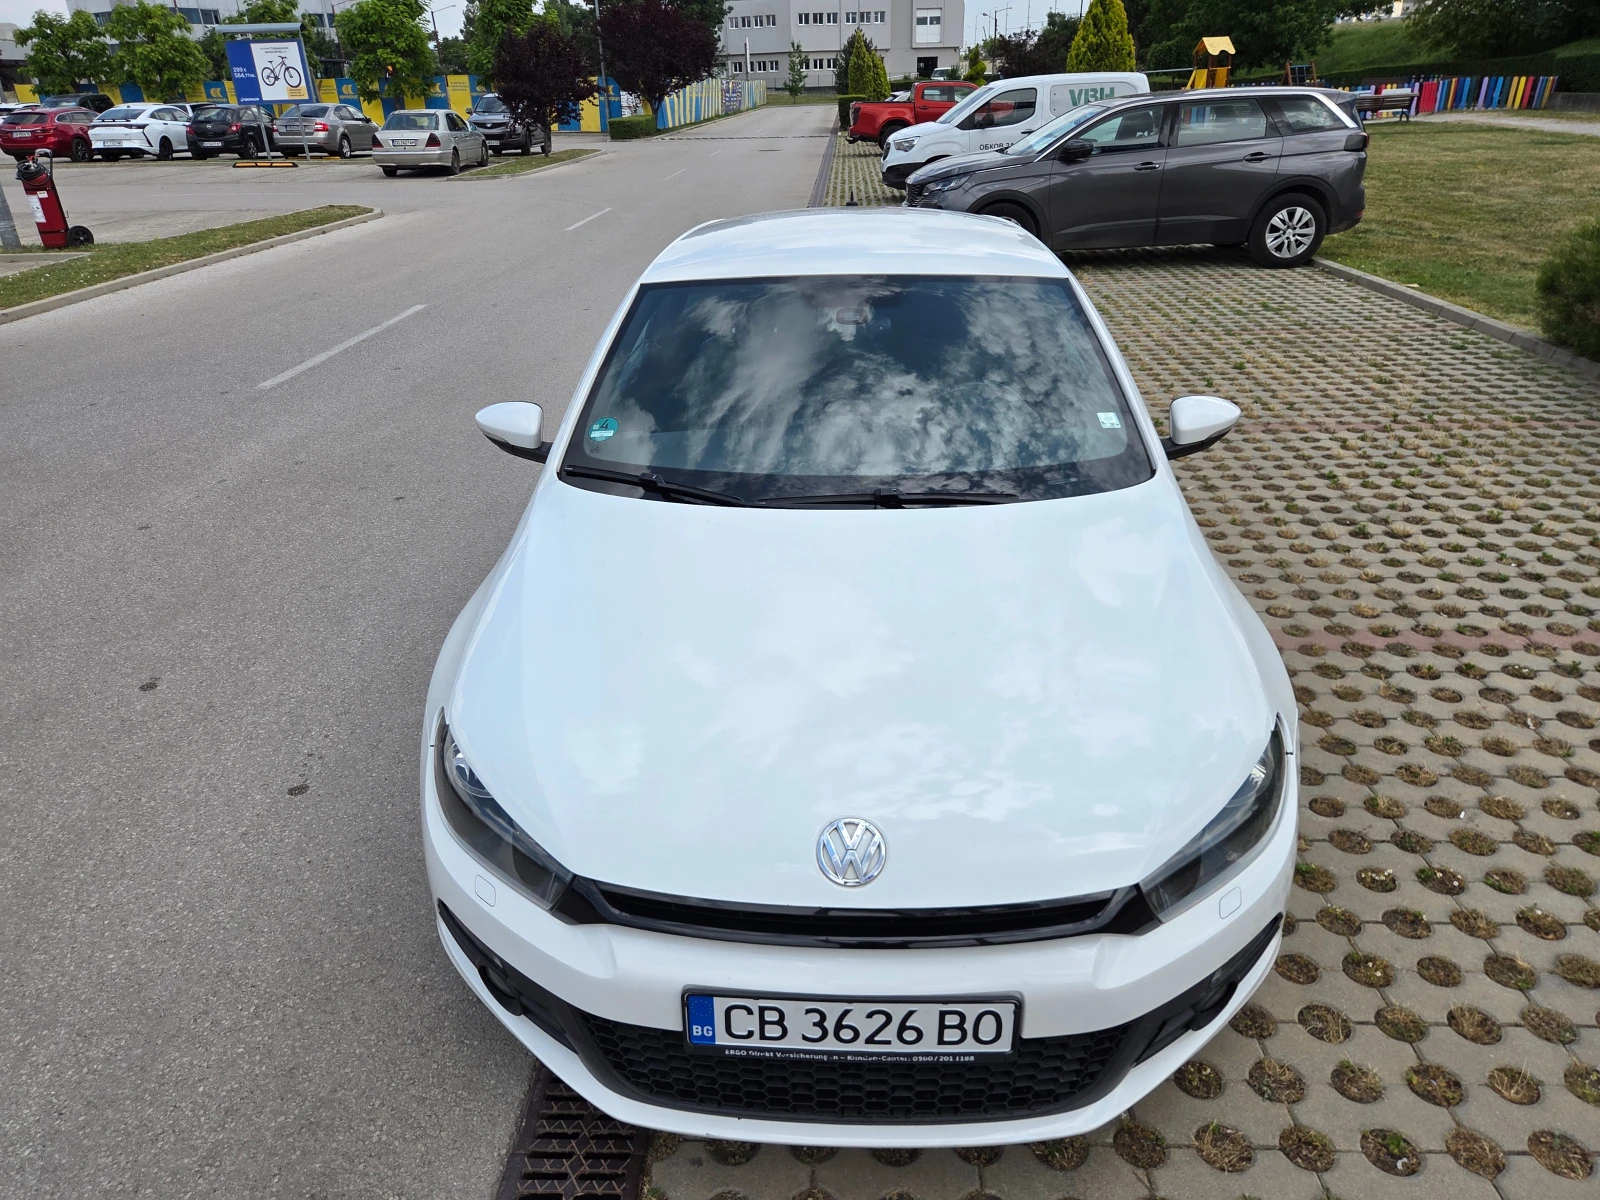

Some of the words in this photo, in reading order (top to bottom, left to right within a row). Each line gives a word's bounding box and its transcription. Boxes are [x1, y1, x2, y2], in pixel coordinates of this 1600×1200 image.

[599, 419, 609, 430] 4
[724, 1003, 788, 1041] CB
[801, 1007, 924, 1045] 3626
[692, 1025, 713, 1037] BG
